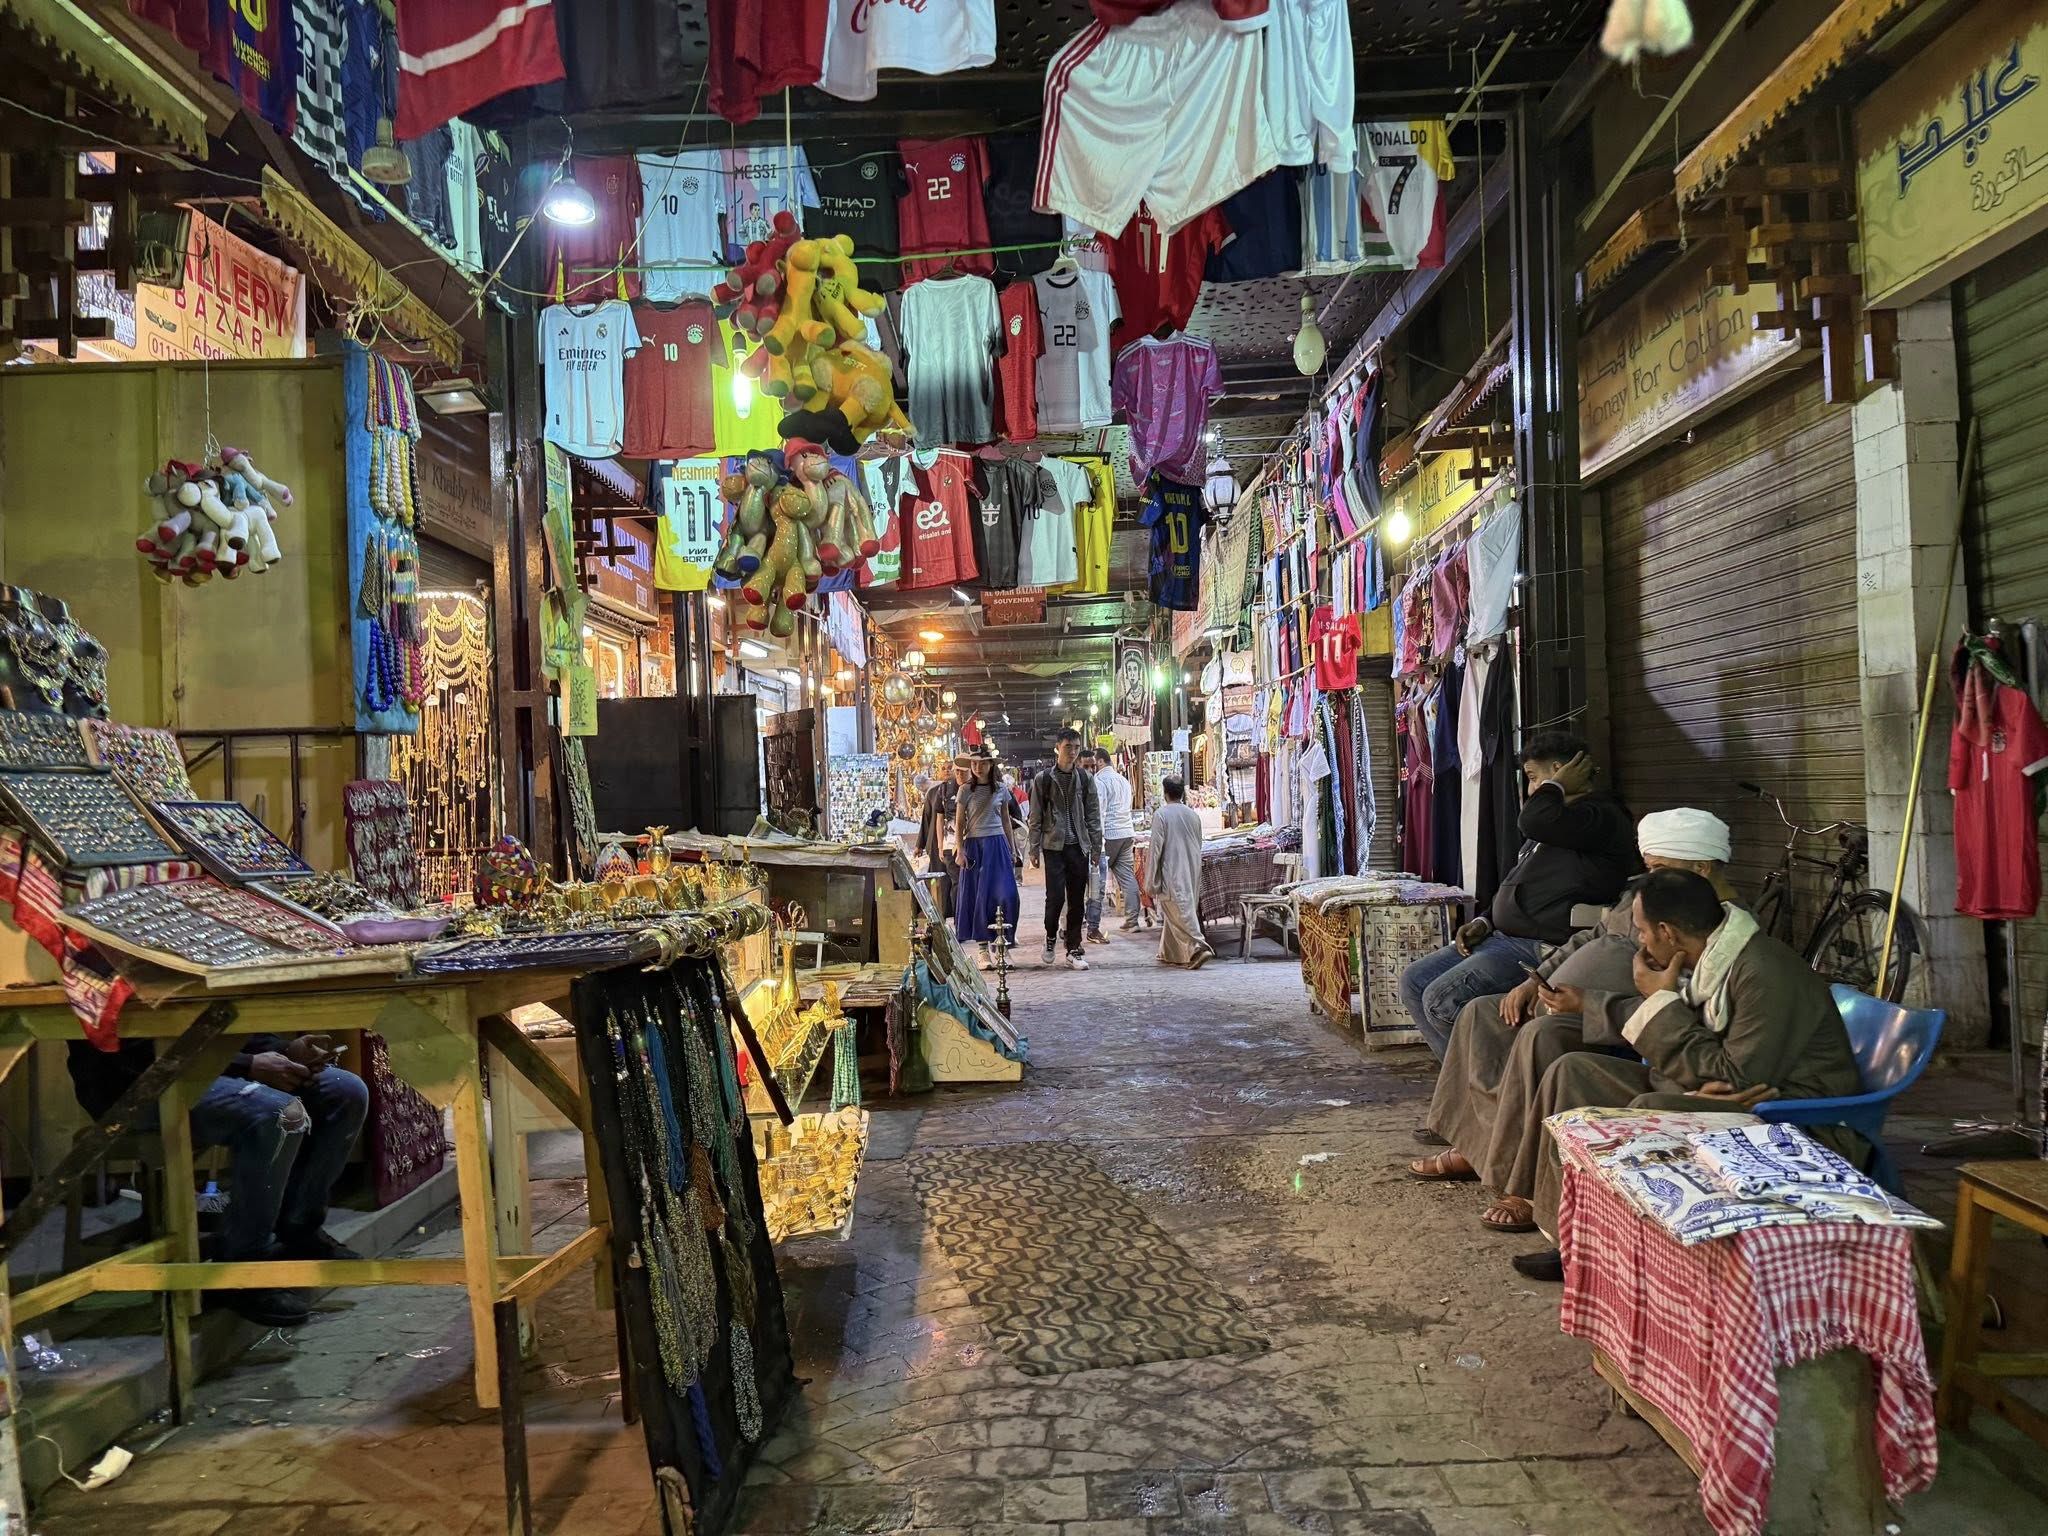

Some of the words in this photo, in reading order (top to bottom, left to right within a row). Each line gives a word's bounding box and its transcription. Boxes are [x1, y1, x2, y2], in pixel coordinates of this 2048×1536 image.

[733, 163, 777, 180] MESSI
[927, 177, 951, 201] 22
[1379, 155, 1417, 215] 7
[661, 194, 678, 216] 10
[823, 208, 865, 218] AIRWAYS
[174, 288, 263, 357] BAZAR
[1053, 324, 1077, 347] 22
[663, 343, 679, 362] 10
[1631, 363, 1663, 402] For
[1668, 306, 1745, 374] Cotton
[577, 360, 598, 371] BETER
[682, 485, 712, 542] 11
[918, 530, 940, 541] etisalat
[941, 528, 952, 537] and
[1165, 511, 1190, 554] 10
[682, 554, 714, 563] SORTE
[993, 596, 1035, 606] SOUVENIRS
[1321, 632, 1343, 664] 11
